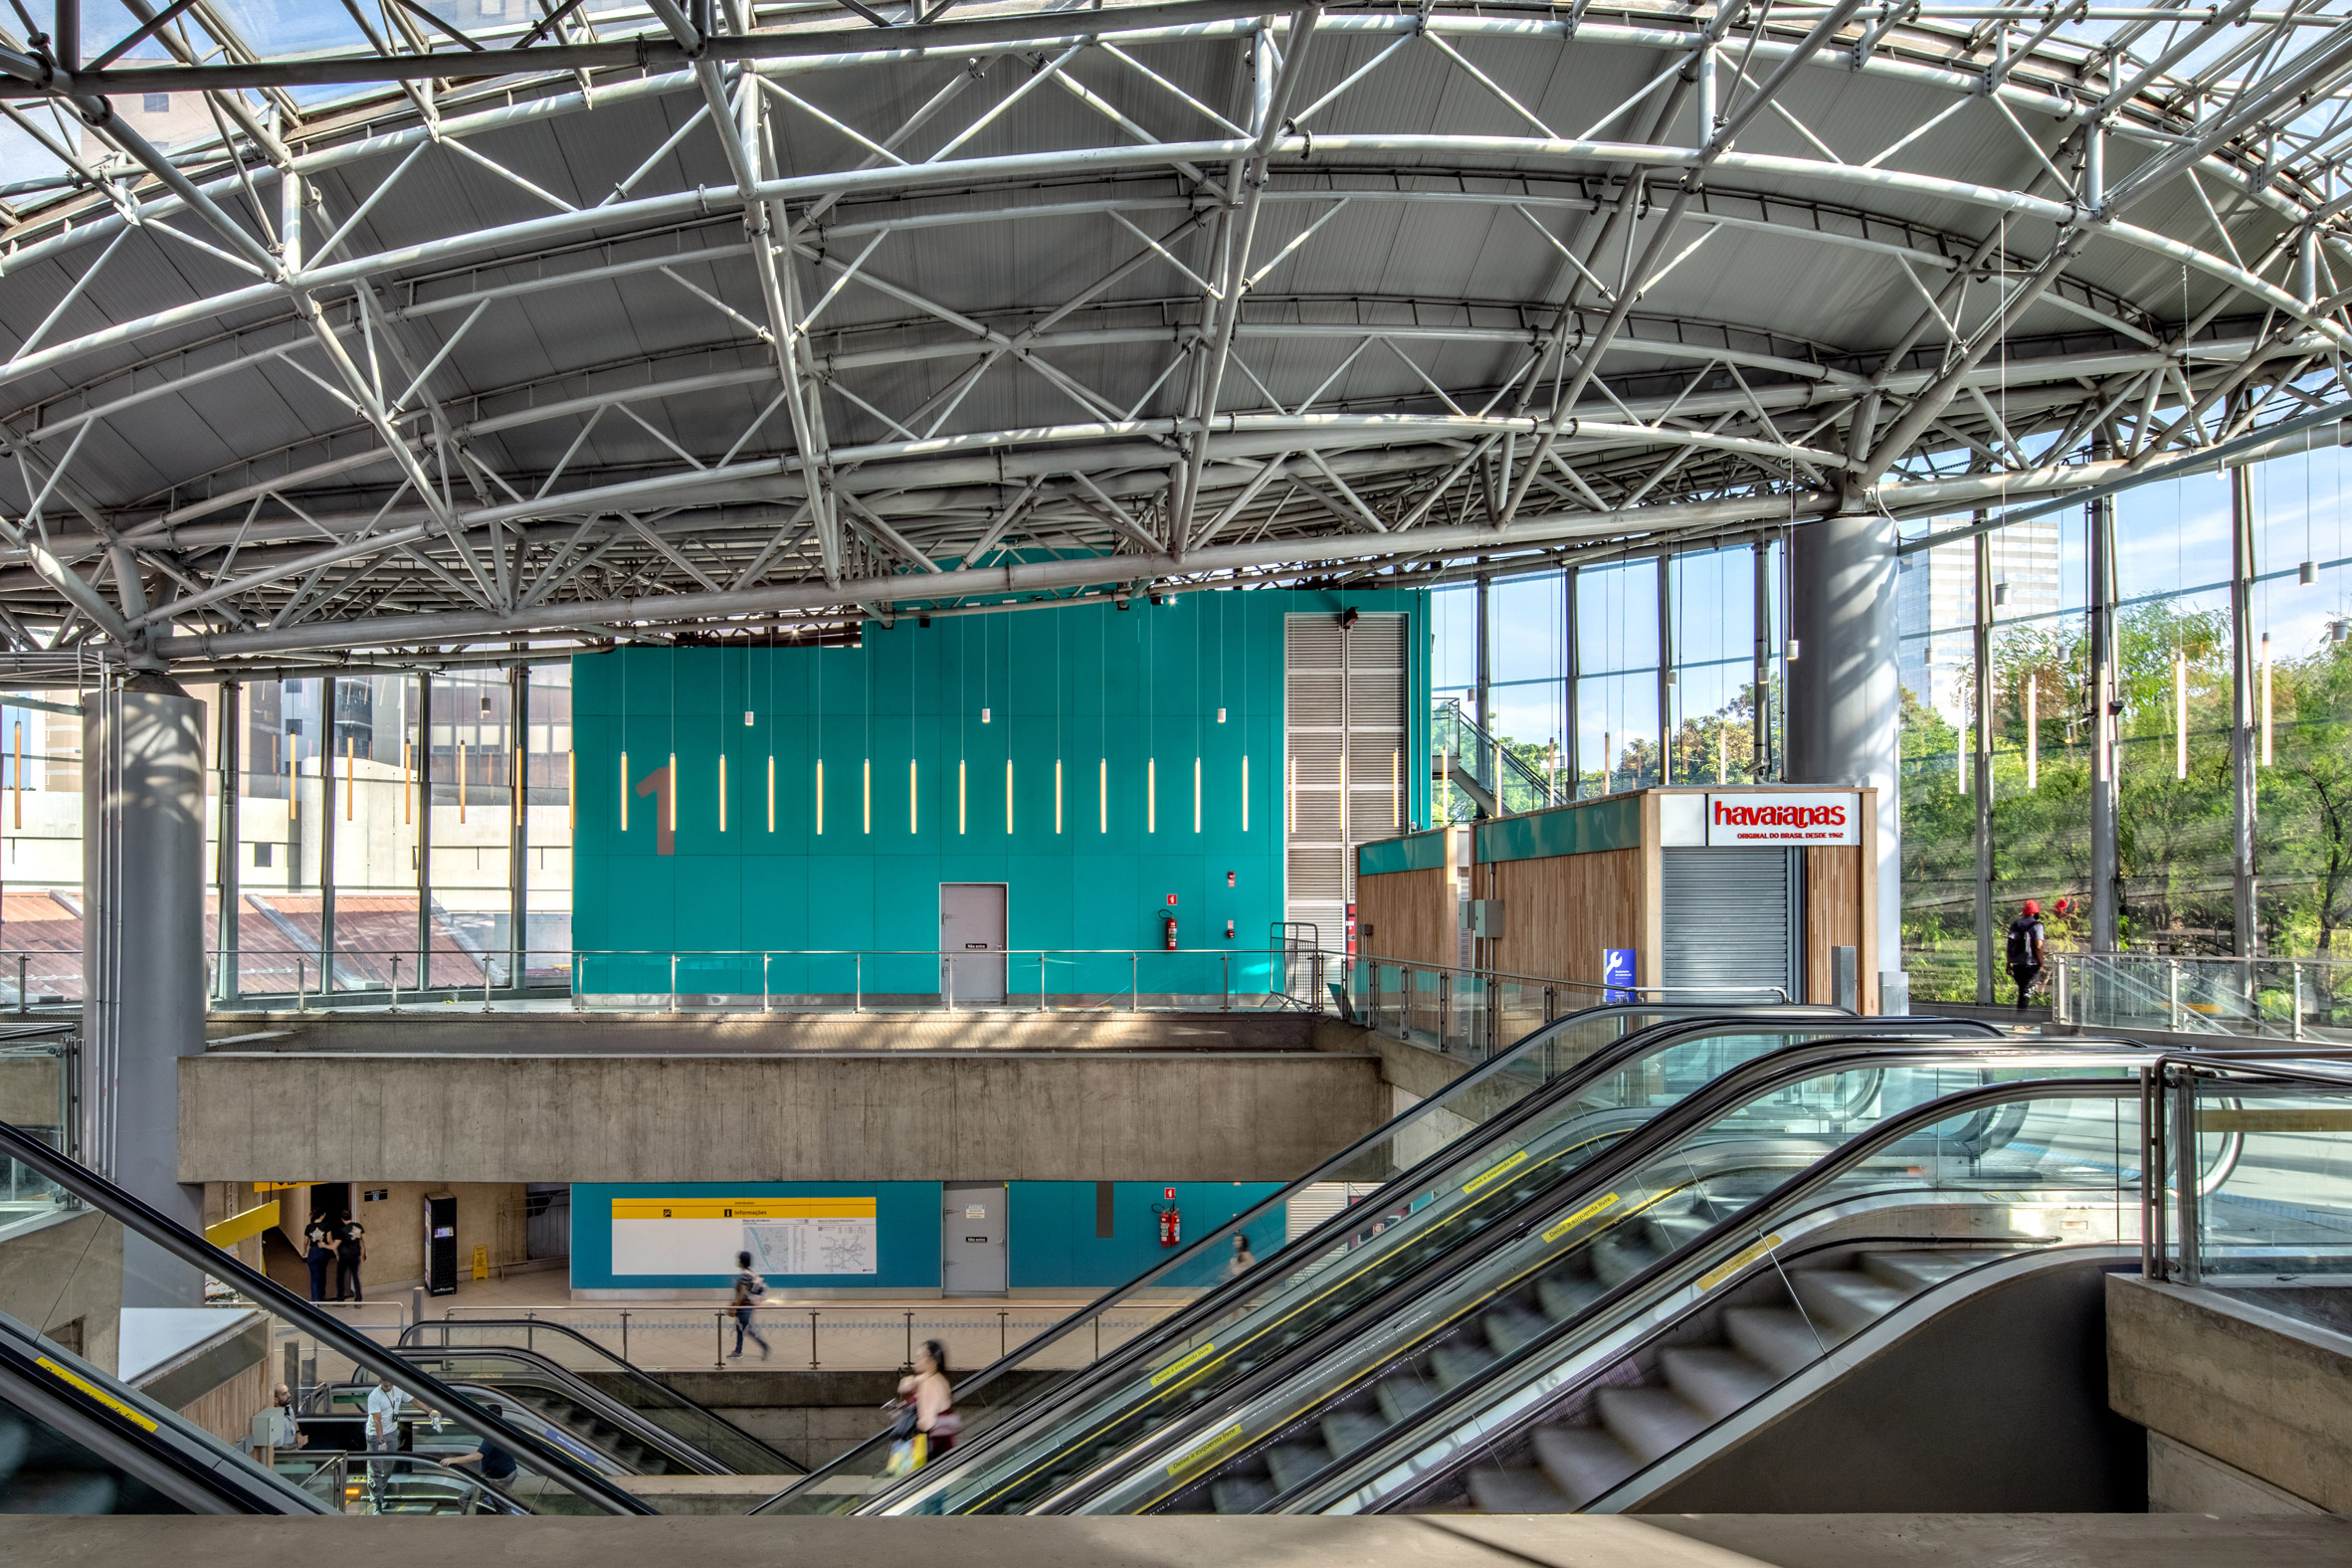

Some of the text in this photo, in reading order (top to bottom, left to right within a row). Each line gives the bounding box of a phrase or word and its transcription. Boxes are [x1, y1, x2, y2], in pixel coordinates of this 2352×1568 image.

[636, 766, 676, 856] 1
[1714, 800, 1847, 829] havaianas
[1469, 1178, 1483, 1190] Deixe
[1487, 1162, 1510, 1178] esquerda
[1548, 1224, 1567, 1238] Deixe
[1571, 1204, 1599, 1225] esquerda
[1598, 1196, 1612, 1207] livre
[1155, 1370, 1170, 1382] Deixe
[1175, 1354, 1198, 1370] esquerda
[1197, 1346, 1209, 1356] livre
[1172, 1456, 1190, 1470] Deixe
[1195, 1436, 1223, 1455] esquerda
[1222, 1428, 1236, 1439] livre
